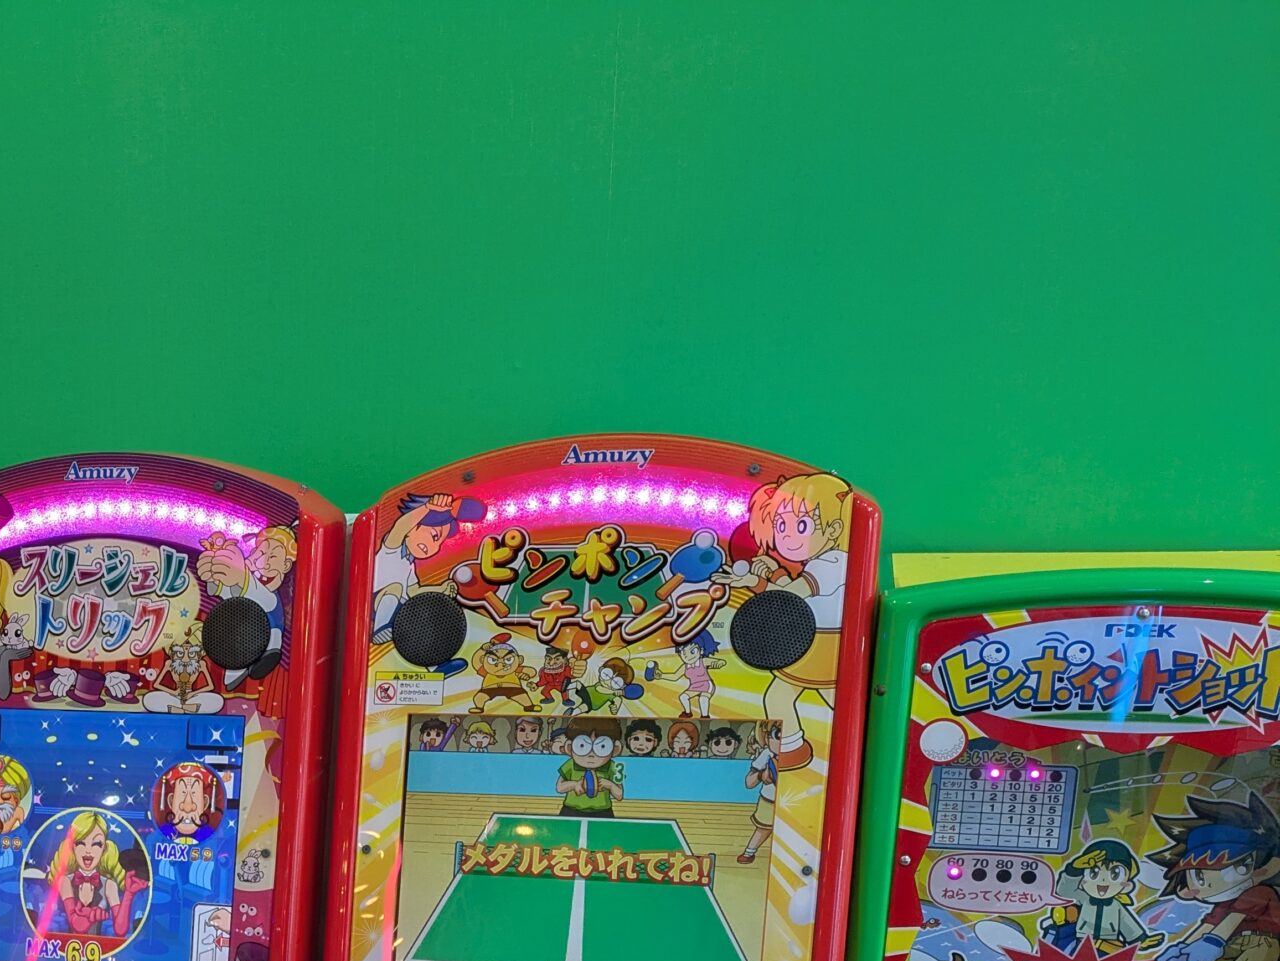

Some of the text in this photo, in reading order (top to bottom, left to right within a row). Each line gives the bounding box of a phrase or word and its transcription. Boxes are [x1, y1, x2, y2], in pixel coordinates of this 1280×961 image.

[562, 444, 655, 468] Amuzy
[65, 462, 139, 484] Amuzy
[479, 526, 666, 590] ピンポン
[530, 582, 728, 642] チャンプ
[34, 595, 170, 656] トリック
[970, 781, 978, 789] 3
[991, 782, 999, 790] 5
[1008, 783, 1020, 791] 10
[1028, 783, 1041, 792] 15
[1047, 784, 1062, 792] 20
[970, 792, 975, 800] 1
[989, 793, 998, 801] 2
[1047, 795, 1060, 803] 15
[1048, 806, 1057, 814] 5
[1008, 816, 1013, 824] 1
[1027, 817, 1035, 825] 2
[1047, 817, 1055, 825] 3
[1027, 827, 1032, 835] 1
[1045, 828, 1054, 836] 2
[2, 837, 21, 850] 99
[1046, 839, 1051, 847] 1
[154, 843, 213, 862] MAX 59
[947, 857, 1039, 871] 60 70 80 90
[941, 887, 1043, 903] ねらってください
[26, 938, 60, 958] MAX
